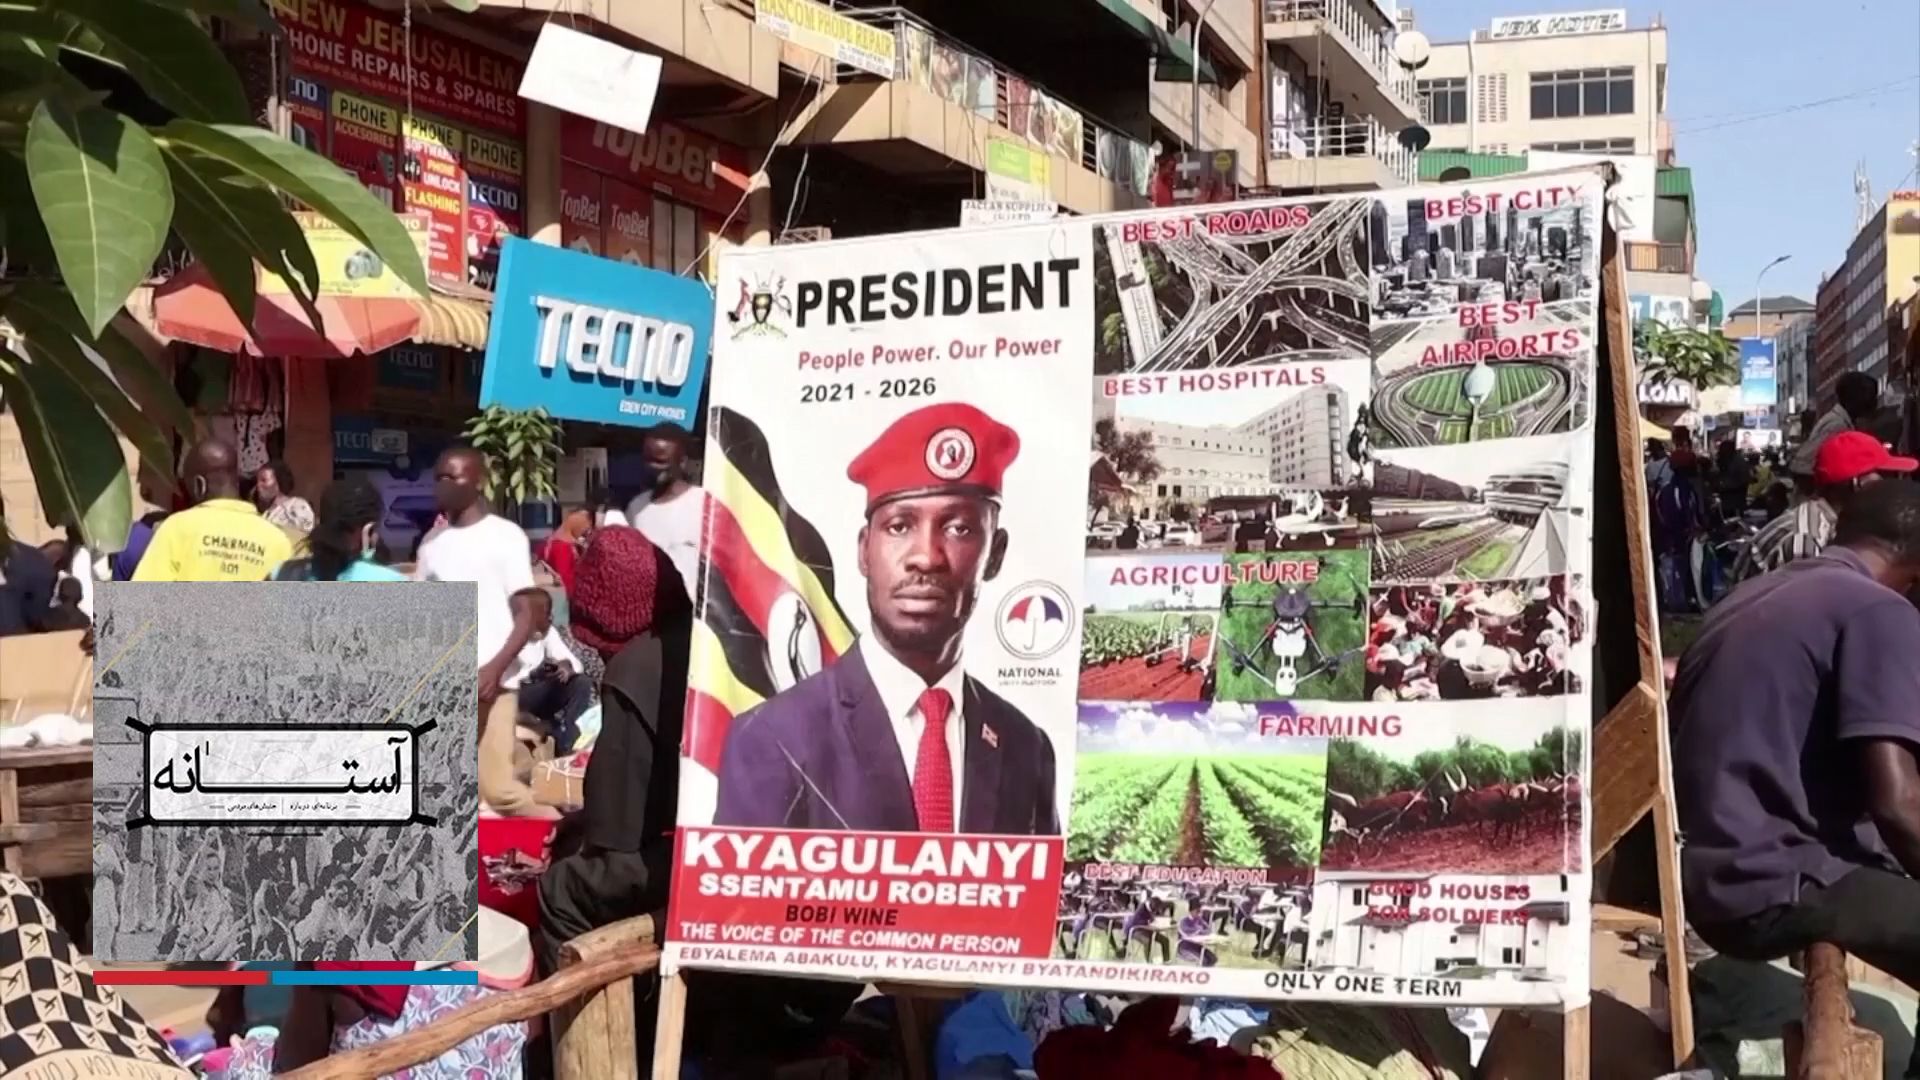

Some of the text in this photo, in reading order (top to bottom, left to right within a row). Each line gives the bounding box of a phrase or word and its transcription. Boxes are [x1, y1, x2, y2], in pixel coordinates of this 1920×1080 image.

[1546, 13, 1623, 34] HOTEL
[281, 24, 346, 65] HONE
[351, 48, 431, 90] REPAIRS
[436, 76, 447, 96] &
[453, 81, 516, 117] SPARES
[356, 15, 516, 96] JERUSALEM
[340, 98, 387, 130] PHONE
[411, 117, 453, 147] PHONE
[471, 140, 518, 169] PHONE
[592, 118, 719, 190] TopBet
[405, 186, 461, 215] FLASHING
[468, 180, 517, 211] TECNO
[560, 188, 600, 225] TopBet
[1426, 184, 1583, 220] BEST CITY
[612, 204, 650, 238] TopBet
[1122, 206, 1310, 243] BEST ROADS
[796, 257, 1080, 328] PRESIDENT
[1459, 299, 1541, 327] BEST
[531, 295, 695, 388] TECNO
[798, 336, 1062, 373] People Power. Our Power
[1420, 328, 1581, 366] AIRPORTS
[800, 382, 855, 403] 2021
[879, 377, 937, 399] 2026
[1104, 367, 1326, 397] BEST HOSPITALS
[1110, 561, 1319, 586] AGRICULTURE
[998, 667, 1062, 679] NATIONAL
[1259, 714, 1402, 737] FARMING
[684, 831, 1049, 881] KYAGULANYI
[1085, 862, 1268, 884] BEST EDUCATION
[699, 873, 1027, 908] SSENTAMU ROBERT
[1370, 881, 1531, 901] GOOD HOUSES
[786, 904, 898, 926] BOBI WINE
[1368, 905, 1530, 926] FOR SOLDIERS
[680, 921, 1021, 954] THE VOICE OF THE COMMON PERSON
[679, 947, 1211, 985] EBYALEMA ABAKULU, KYAGULANYI BYATANDIKIRAKO
[1264, 971, 1462, 997] ONLY ONE TERM
